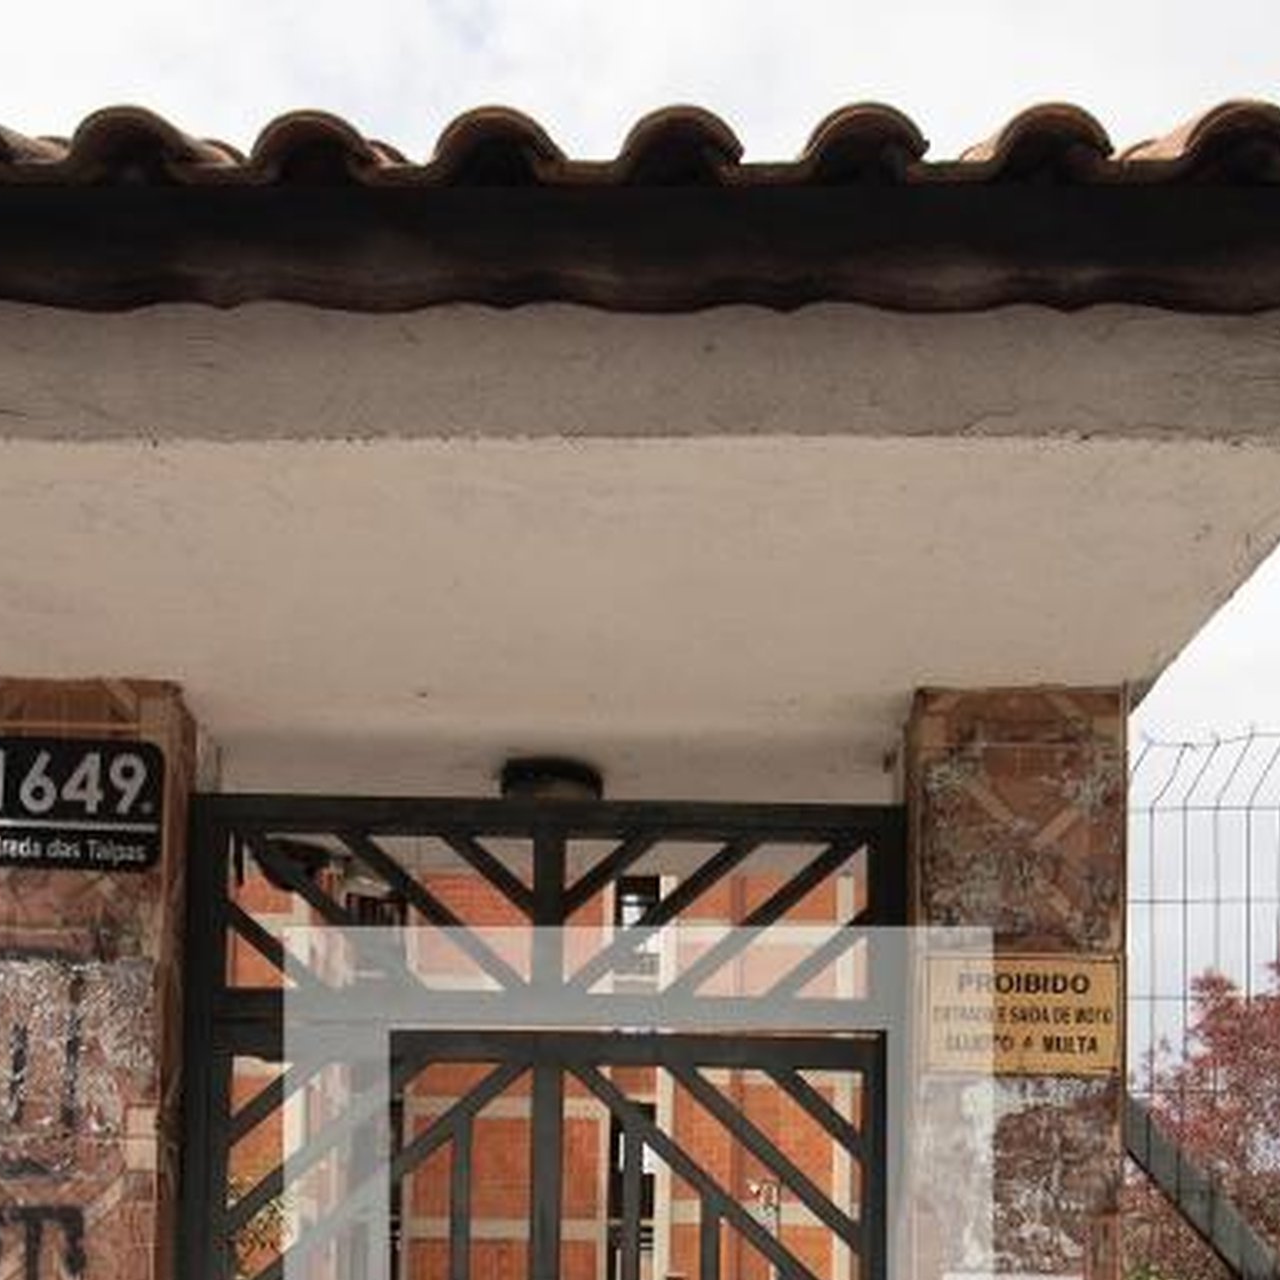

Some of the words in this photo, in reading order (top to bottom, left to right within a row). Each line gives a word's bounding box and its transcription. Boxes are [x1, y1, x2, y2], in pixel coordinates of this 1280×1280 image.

[47, 839, 81, 859] das
[86, 839, 148, 866] Taipas
[959, 973, 1090, 994] PROIBIDO
